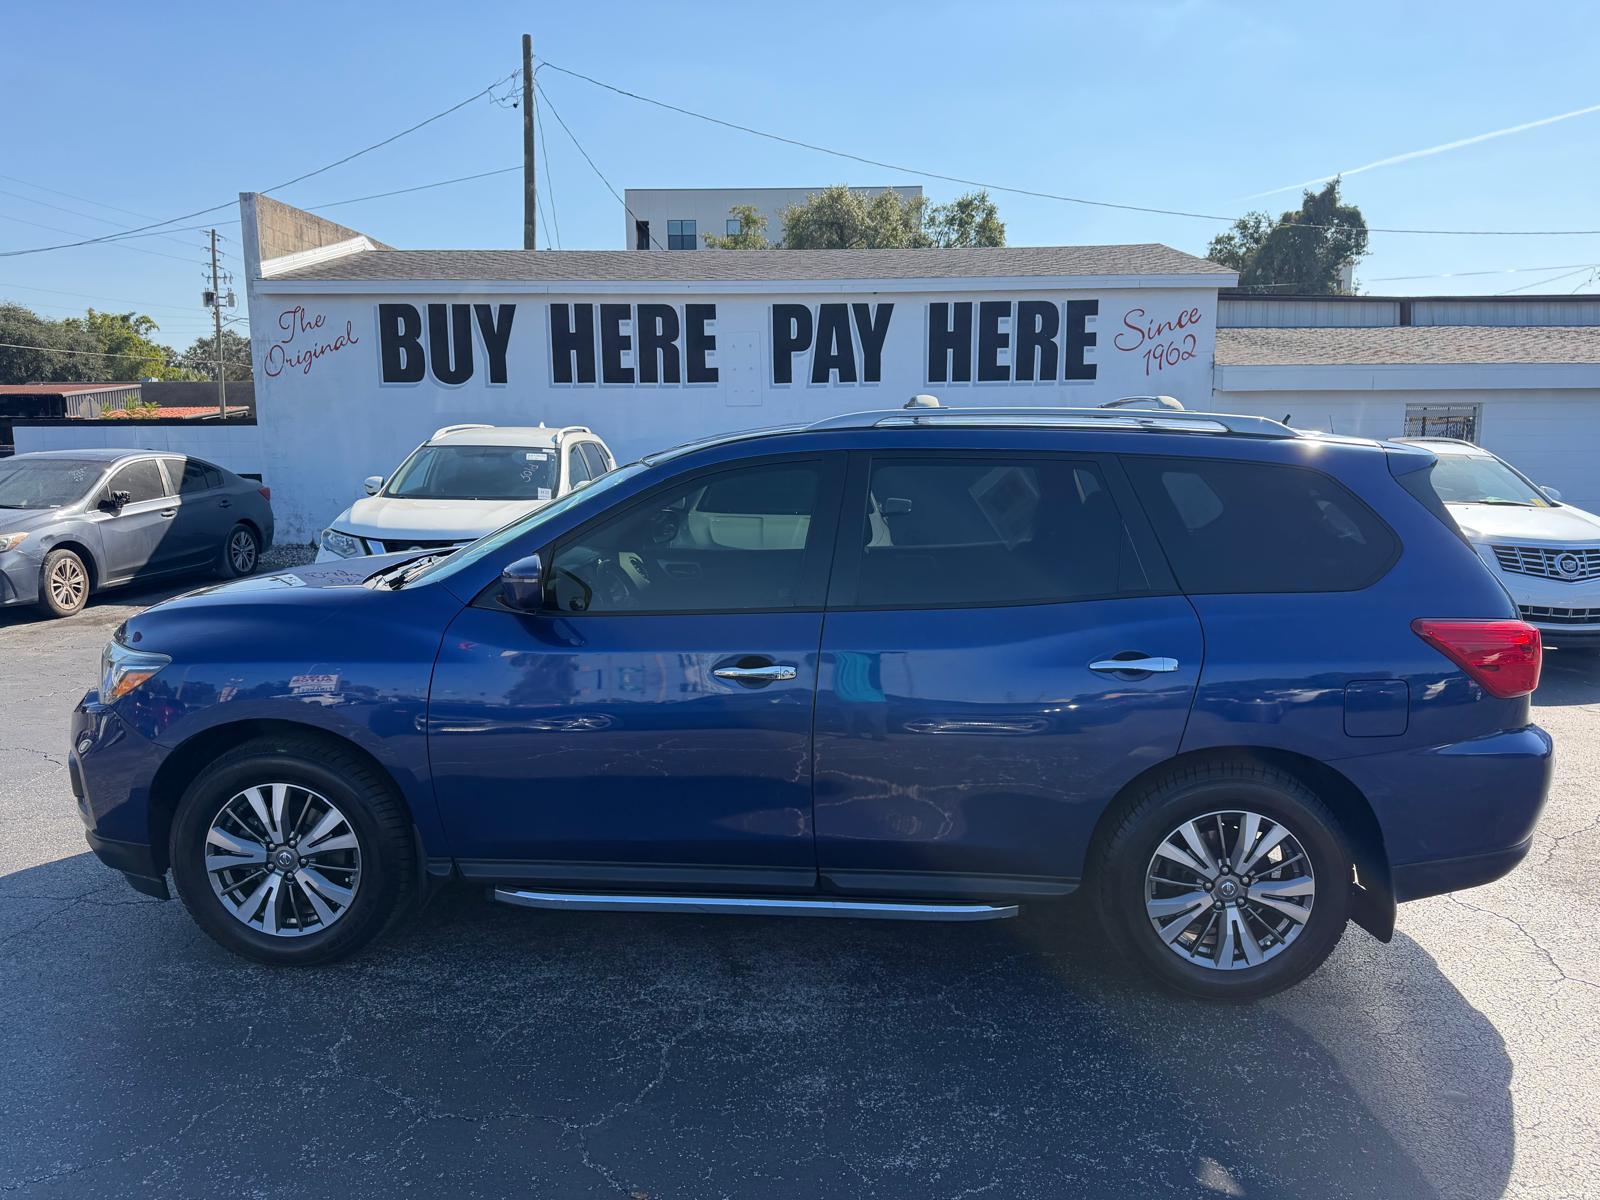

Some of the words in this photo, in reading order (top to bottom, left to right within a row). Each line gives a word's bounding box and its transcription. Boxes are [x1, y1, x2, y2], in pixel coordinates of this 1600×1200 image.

[279, 305, 326, 344] The
[378, 303, 517, 385] BUY
[550, 303, 719, 384] HERE
[771, 302, 895, 384] PAY
[927, 299, 1099, 383] HERE
[1114, 307, 1202, 352] Since
[264, 320, 360, 377] Original
[1143, 333, 1198, 376] 1962
